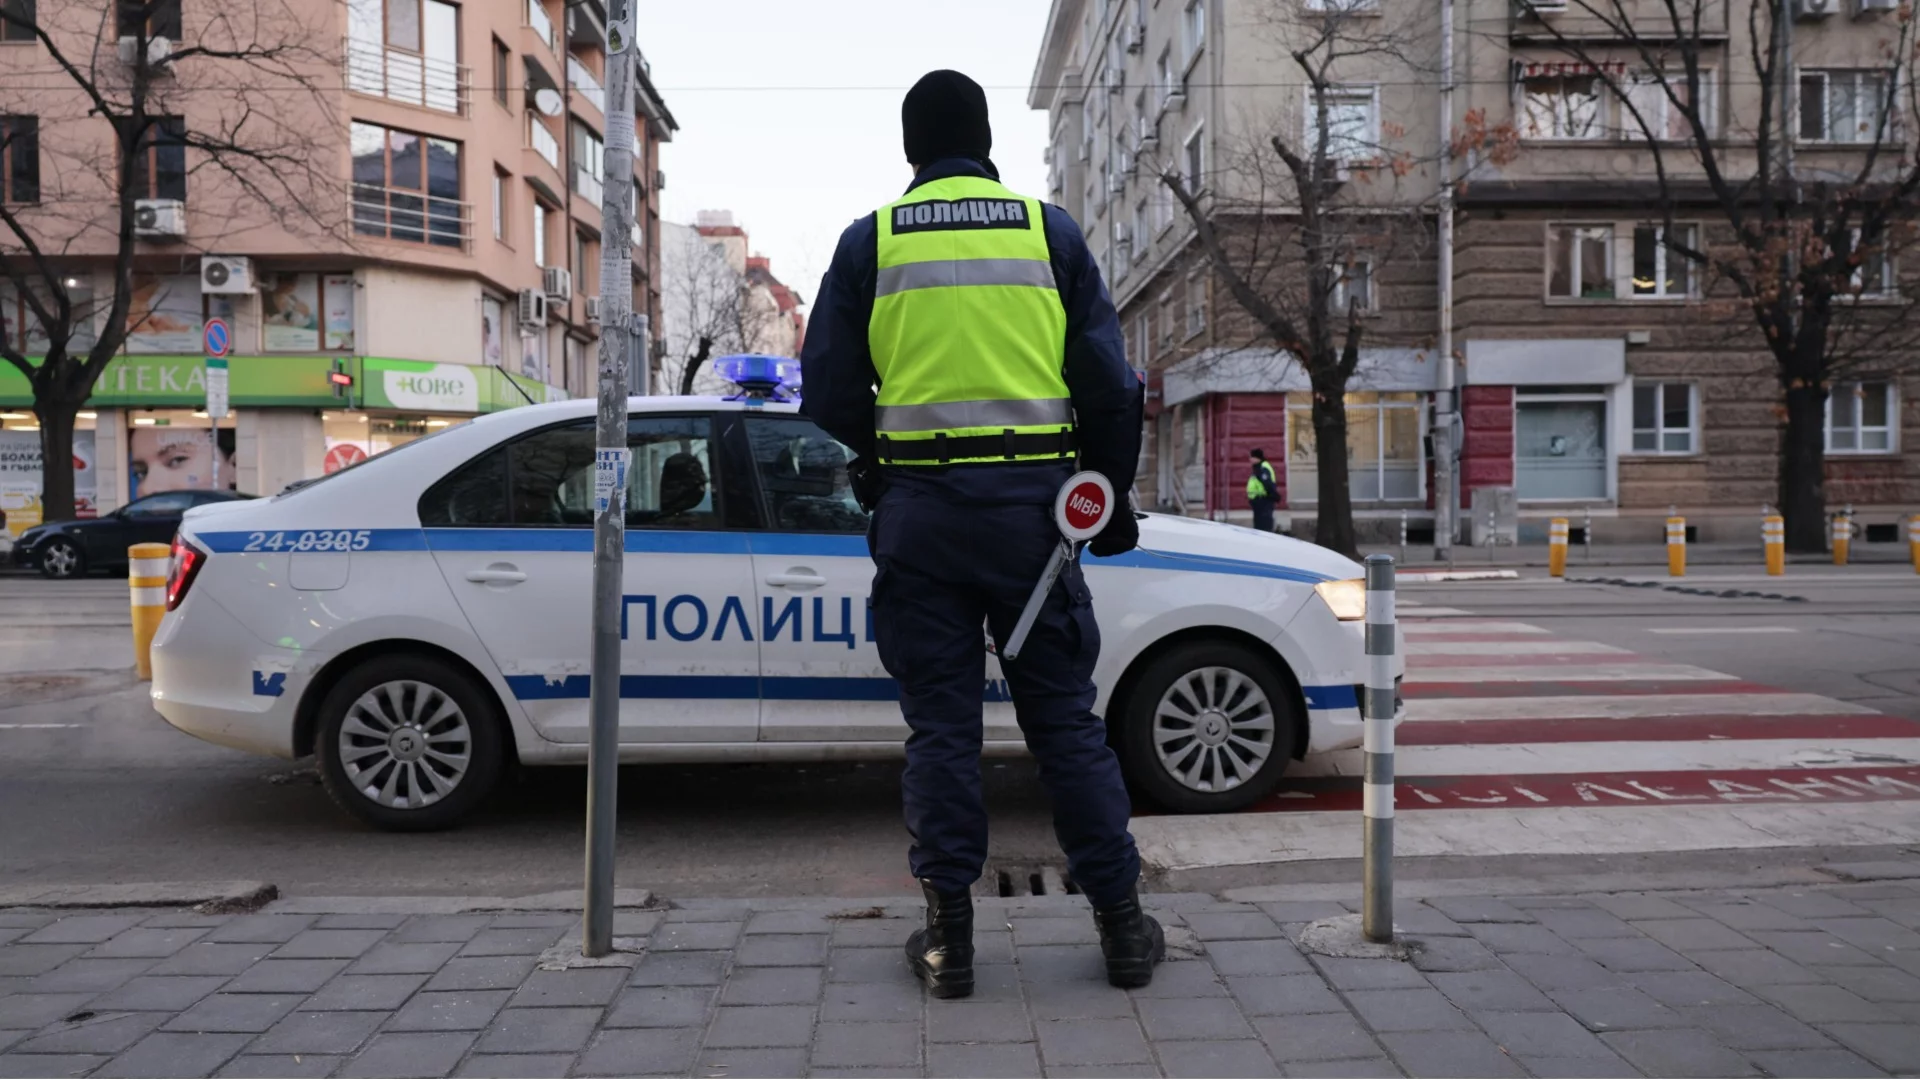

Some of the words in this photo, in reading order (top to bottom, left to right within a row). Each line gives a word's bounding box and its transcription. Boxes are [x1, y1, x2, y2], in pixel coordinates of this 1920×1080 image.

[897, 200, 1024, 226] ПОЛИЦИЯ
[98, 366, 208, 392] ТЕКА
[1069, 493, 1102, 517] МВР
[243, 530, 371, 551] 24-0305
[621, 594, 877, 650] ПОЛИЦ
